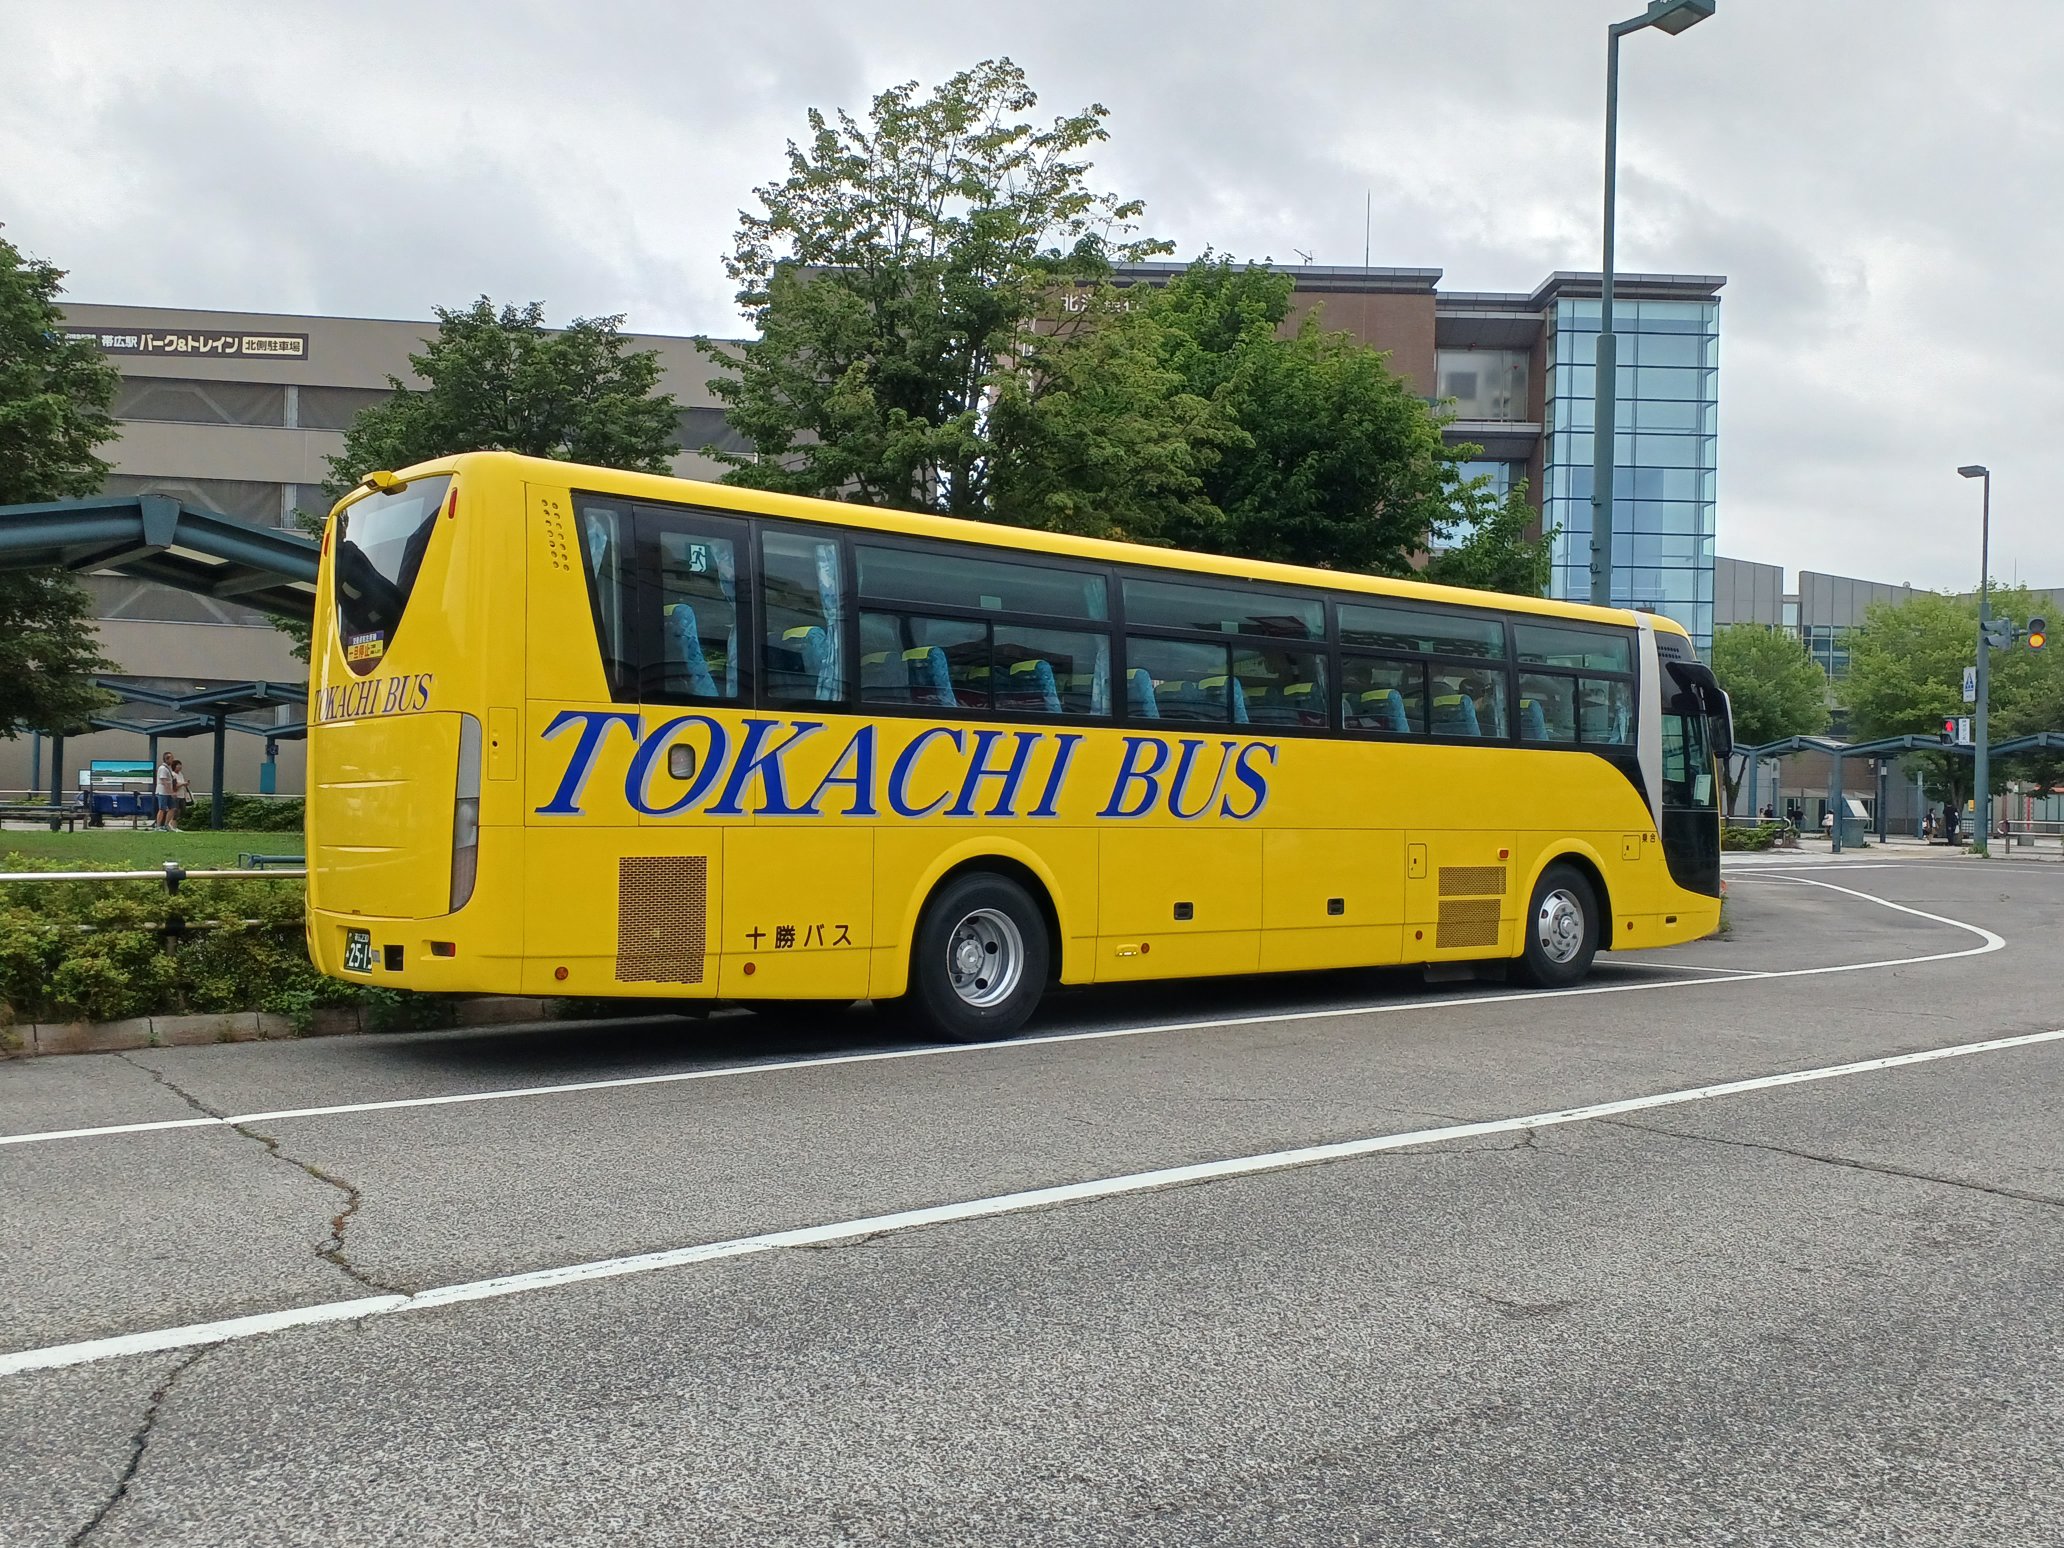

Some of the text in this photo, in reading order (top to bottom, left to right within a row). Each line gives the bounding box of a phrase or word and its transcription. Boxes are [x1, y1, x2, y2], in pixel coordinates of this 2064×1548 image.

[101, 334, 138, 348] 帯広駅
[140, 335, 239, 353] パーク&トレイン
[245, 340, 301, 352] 北側駐車場
[382, 673, 433, 713] BUS
[534, 710, 1280, 821] TOKACHI BUS
[745, 923, 852, 950] 十勝バス
